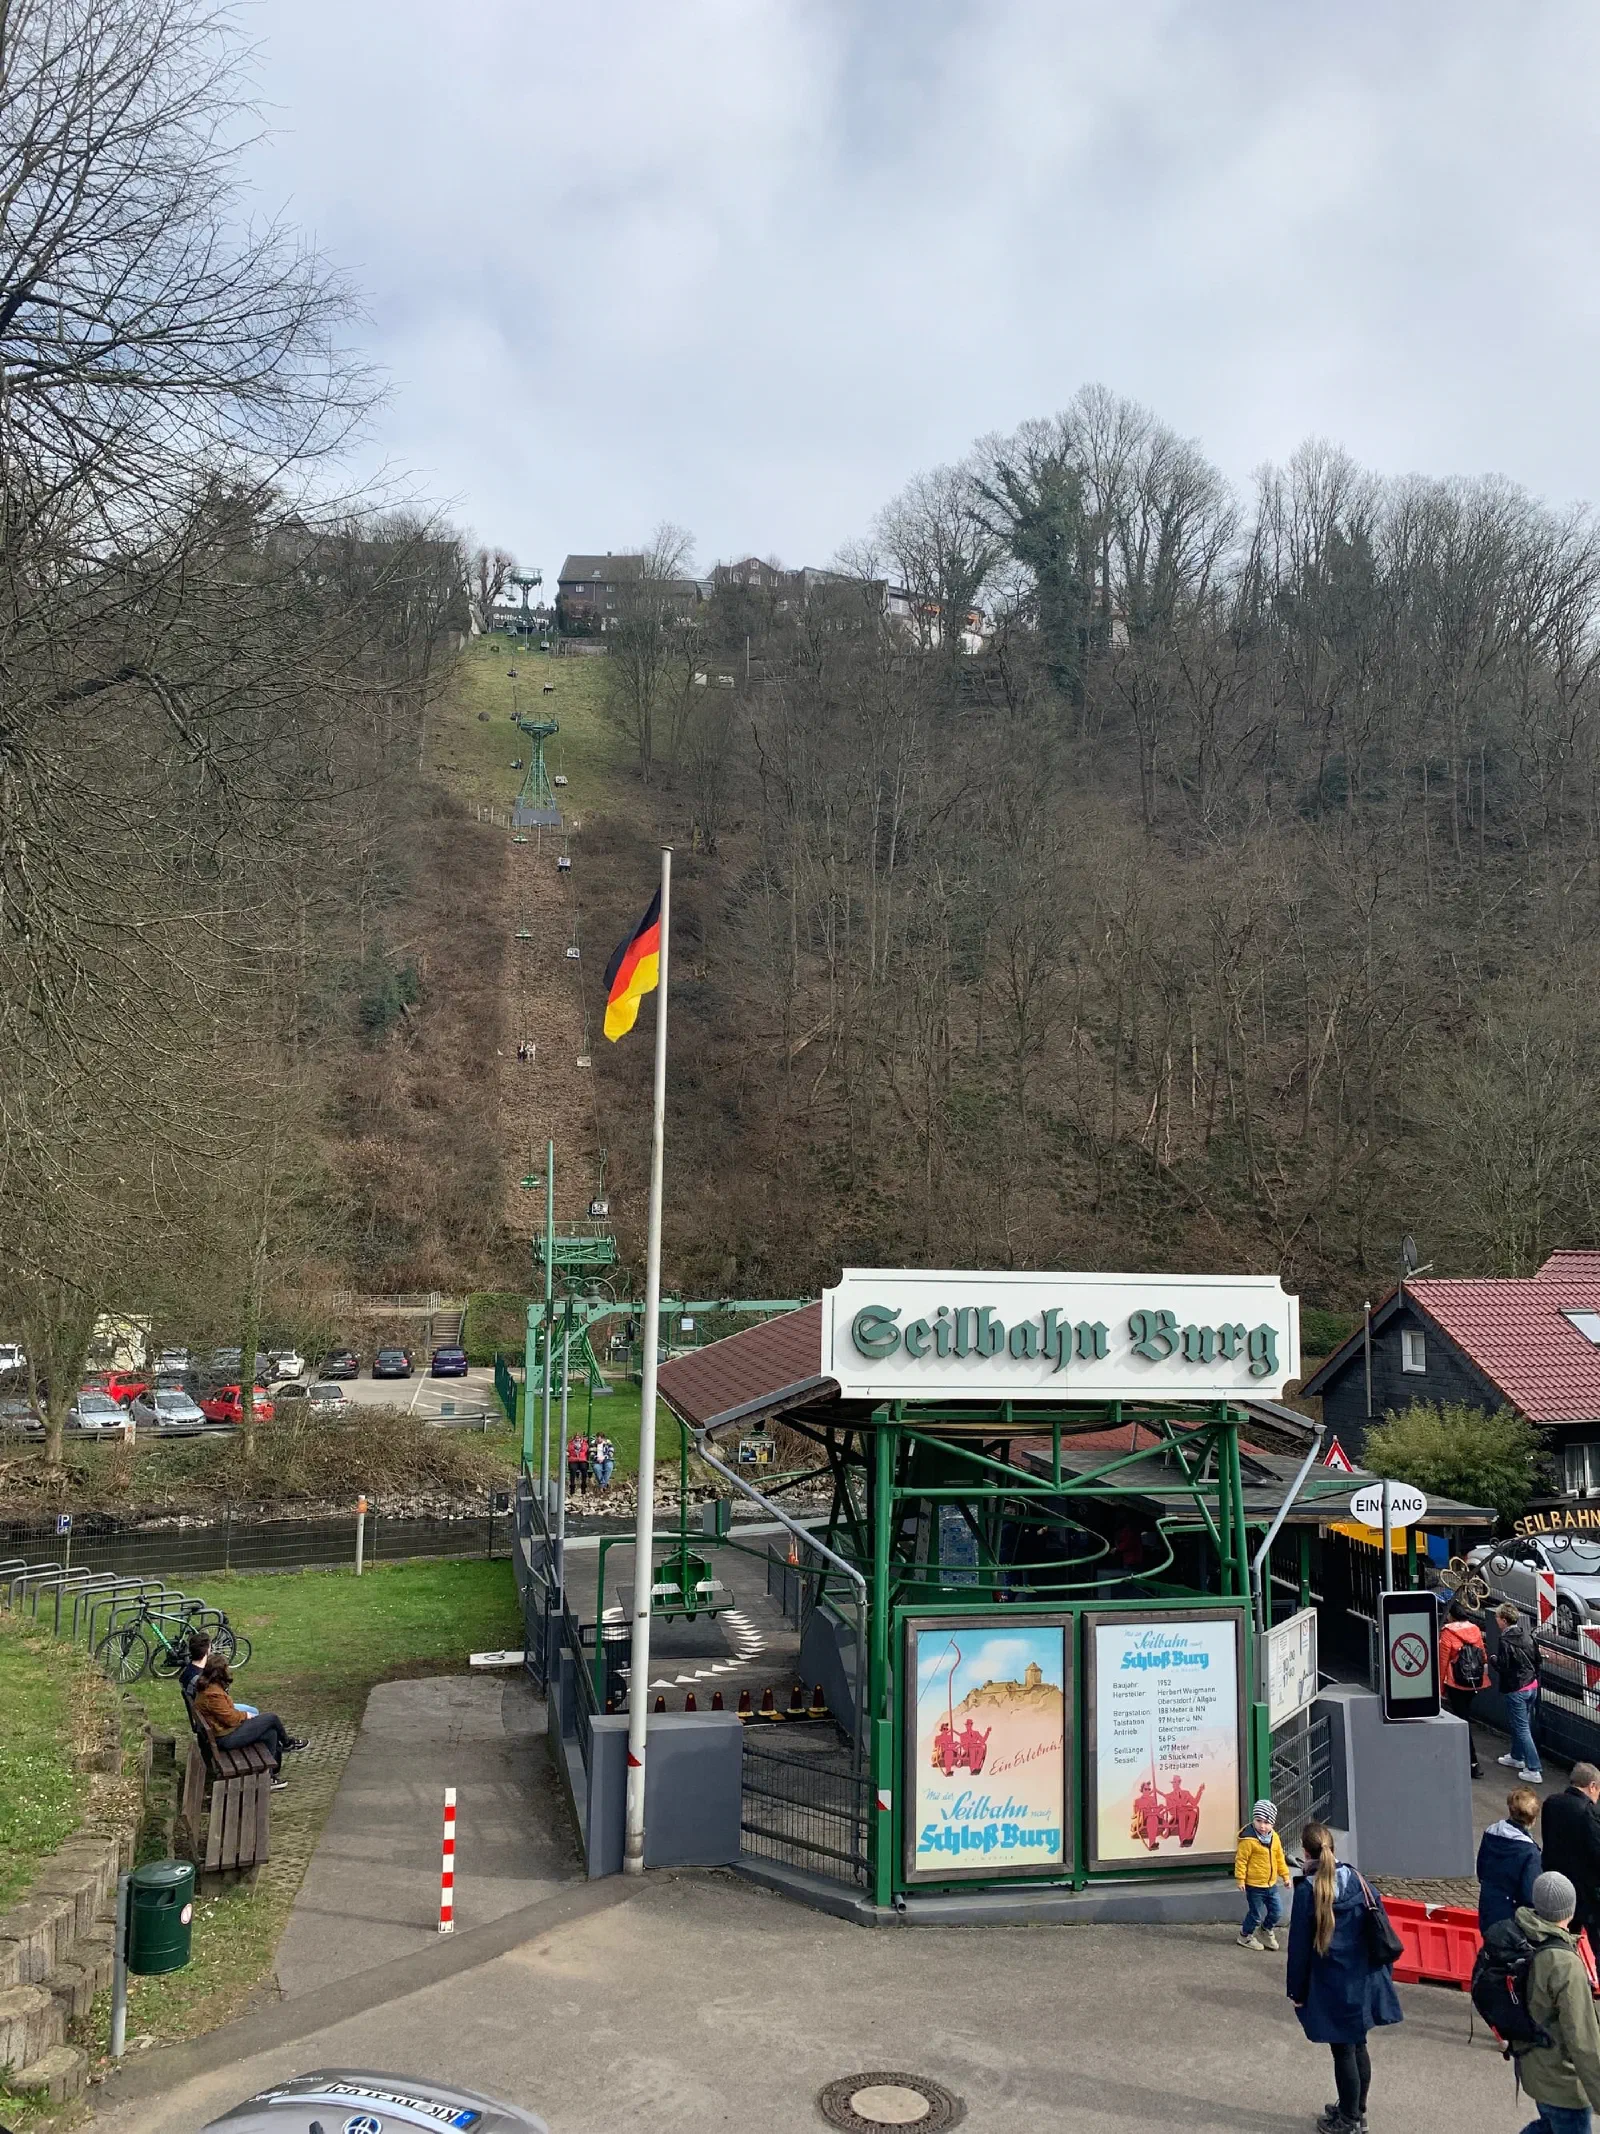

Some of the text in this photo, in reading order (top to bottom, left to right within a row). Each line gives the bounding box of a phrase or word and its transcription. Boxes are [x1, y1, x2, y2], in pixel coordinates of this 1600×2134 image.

[851, 1304, 1280, 1377] Seilbahn Burg
[1356, 1499, 1422, 1511] EINANG
[61, 1515, 70, 1526] P
[1513, 1509, 1600, 1537] SEILBAHN
[1133, 1630, 1188, 1649] Seilbahn
[1120, 1651, 1209, 1671] Schloß Burg
[1158, 1688, 1182, 1697] Herbert
[989, 1734, 1063, 1775] Ein Erlebnis!
[940, 1790, 1028, 1820] Seilbahn
[917, 1823, 1060, 1855] Schloß Burg
